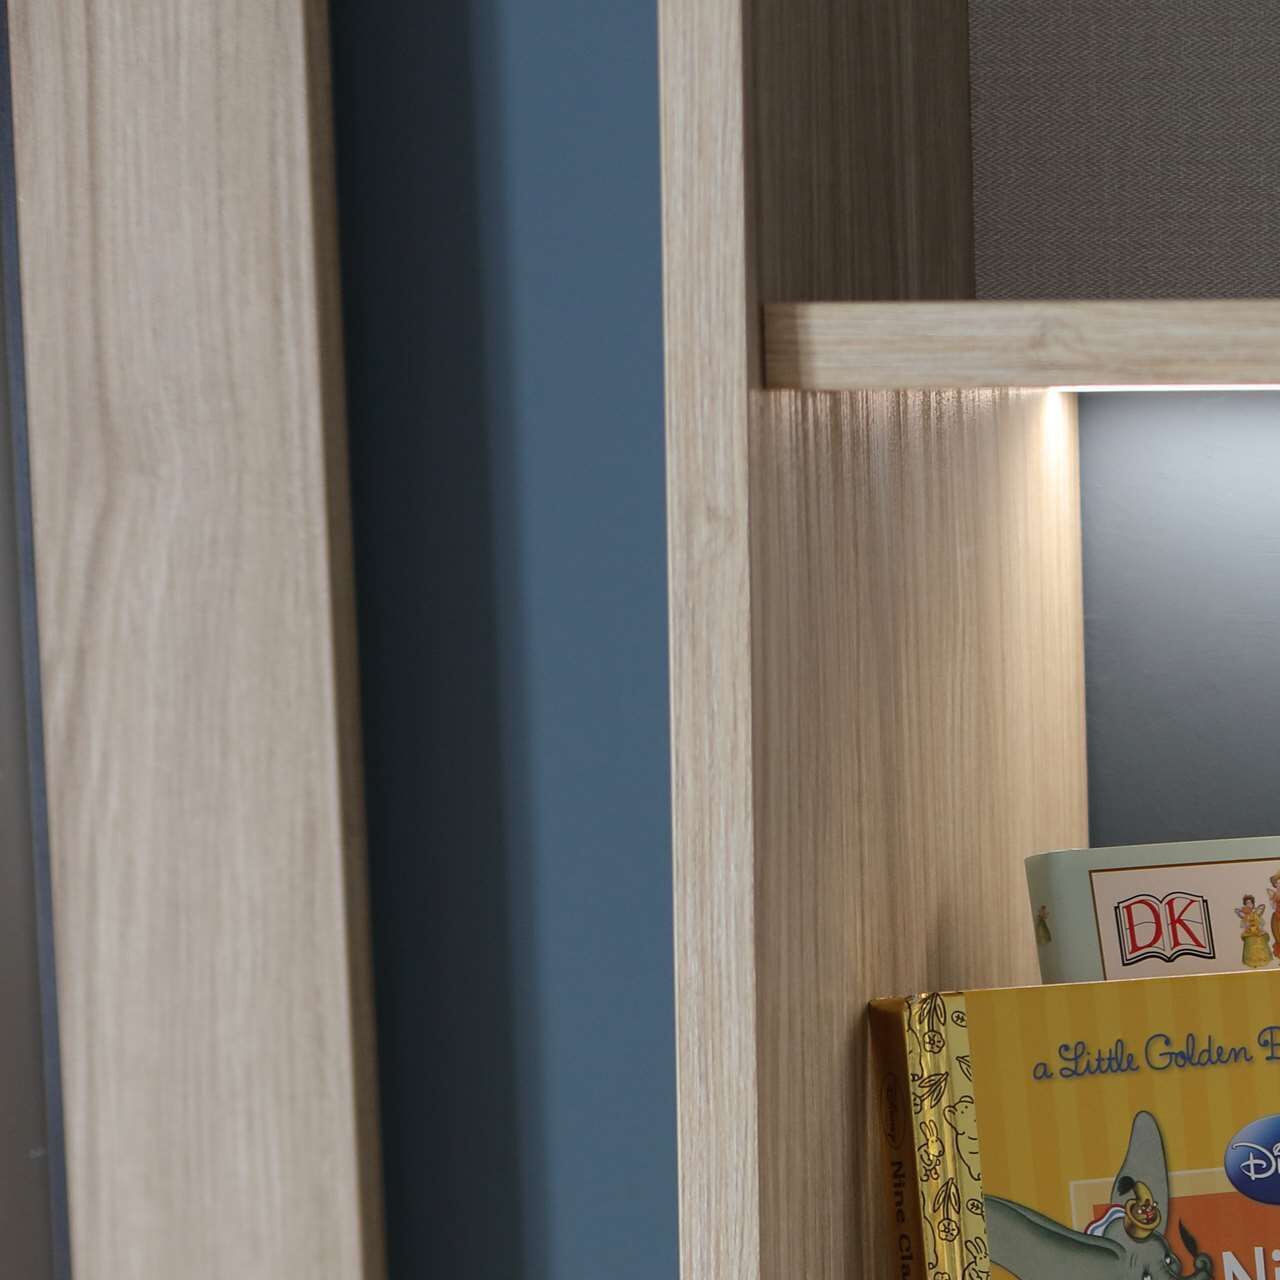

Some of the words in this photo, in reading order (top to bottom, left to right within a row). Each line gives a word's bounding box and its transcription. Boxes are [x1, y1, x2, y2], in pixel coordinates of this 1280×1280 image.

[1122, 896, 1207, 955] DK
[1032, 1058, 1053, 1081] a
[1058, 1038, 1140, 1079] Little
[1144, 1027, 1254, 1071] Golden
